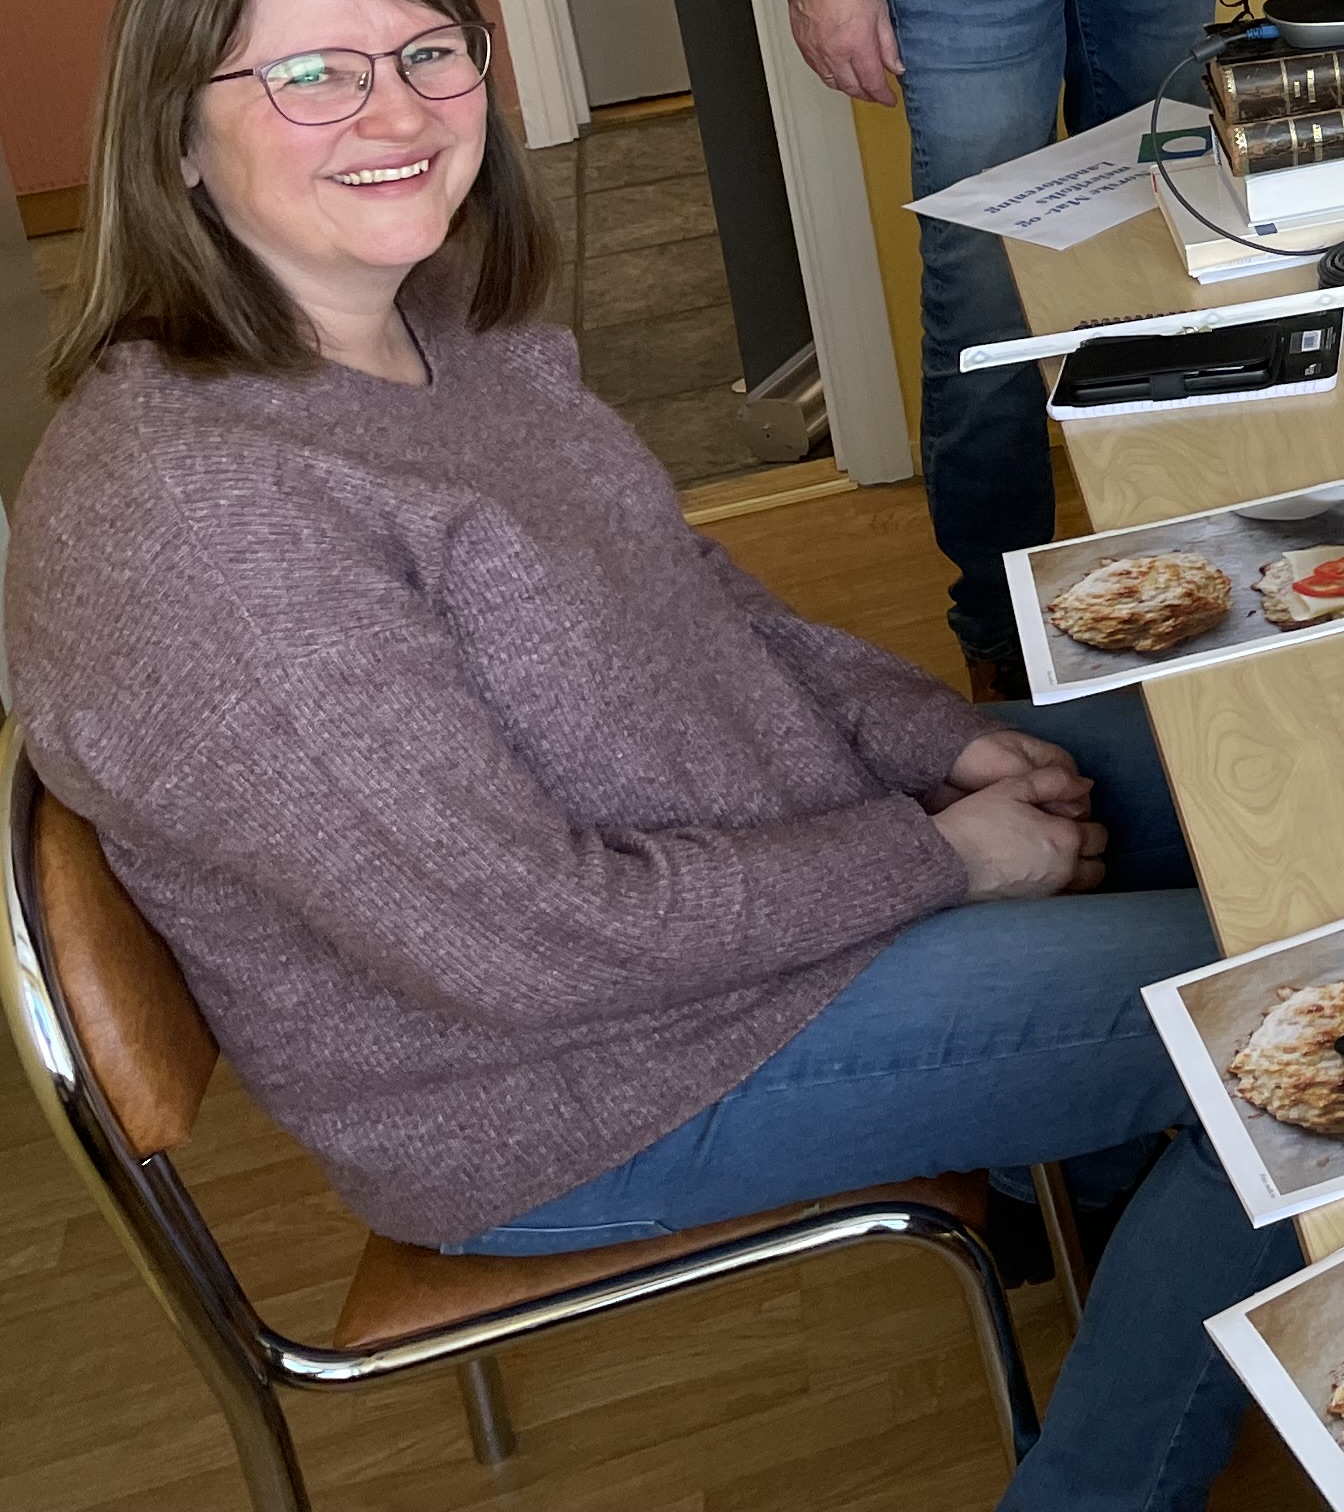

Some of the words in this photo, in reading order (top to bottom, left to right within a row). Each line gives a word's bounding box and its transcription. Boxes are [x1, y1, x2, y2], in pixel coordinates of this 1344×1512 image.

[983, 160, 1116, 215] Landsforening
[1035, 165, 1132, 205] meierifolks
[1014, 216, 1042, 228] og
